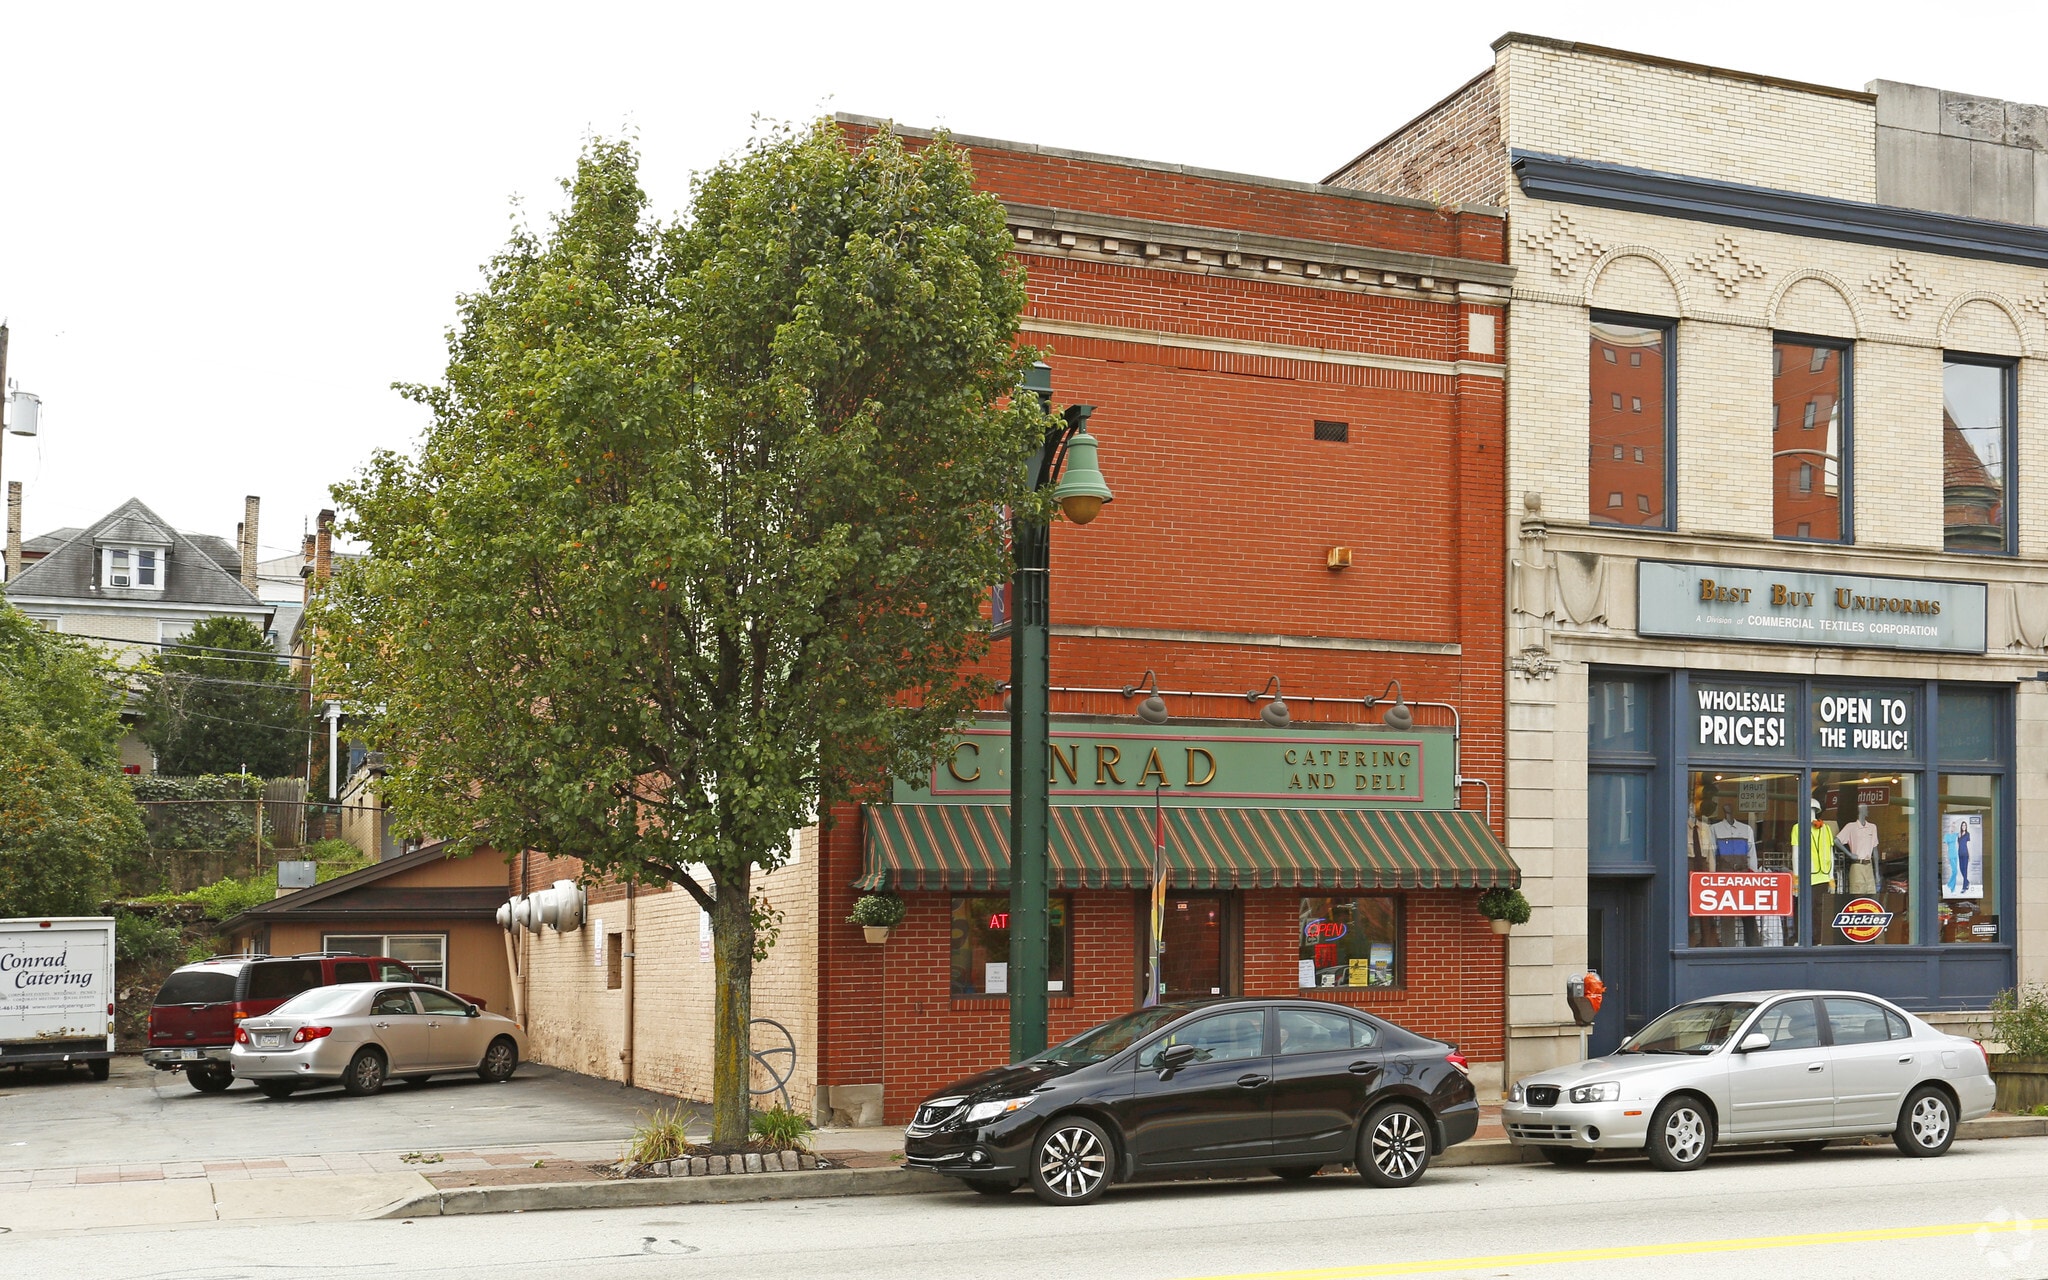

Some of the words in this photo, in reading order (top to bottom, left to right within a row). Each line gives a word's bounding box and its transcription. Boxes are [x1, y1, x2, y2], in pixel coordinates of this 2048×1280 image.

[1700, 578, 1752, 604] BEST
[1771, 583, 1816, 608] BUY
[1835, 587, 1942, 616] UNIFORMS
[1706, 615, 1732, 625] Division
[1736, 617, 1744, 625] of
[1748, 615, 1814, 629] COMMERCIAL
[1820, 619, 1865, 632] TEXTILES
[1869, 623, 1938, 636] CORPORATION
[1698, 690, 1785, 713] WHOLESALE
[1820, 696, 1872, 724] OPEN
[1880, 698, 1907, 725] TO
[1700, 715, 1785, 747] PRICES!
[1819, 727, 1846, 748] THE
[1853, 729, 1908, 750] PUBLIC!
[949, 741, 1217, 786] CNRAD
[1284, 748, 1412, 767] CATERING
[1288, 772, 1336, 789] AND
[1355, 773, 1406, 791] DELI
[1700, 876, 1778, 887] CLEARANCE
[1699, 890, 1778, 911] SALE!
[1307, 922, 1343, 937] OPEN
[1838, 915, 1887, 925] Dickies
[0, 950, 67, 971] Conrad
[15, 970, 93, 988] Catering
